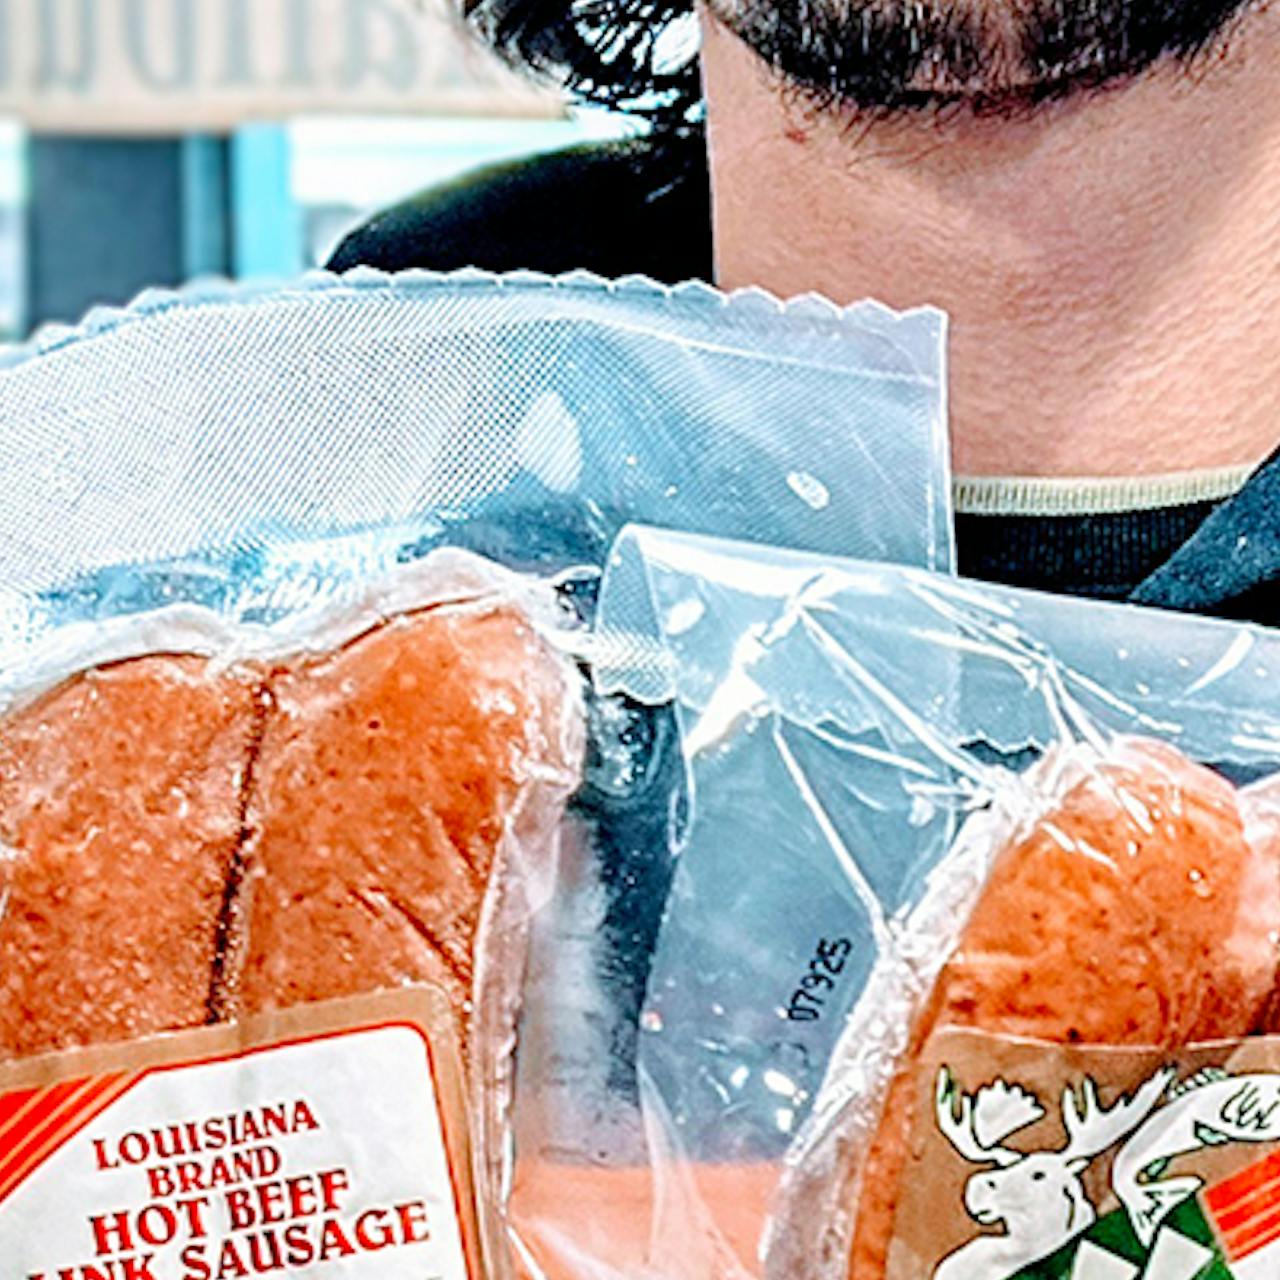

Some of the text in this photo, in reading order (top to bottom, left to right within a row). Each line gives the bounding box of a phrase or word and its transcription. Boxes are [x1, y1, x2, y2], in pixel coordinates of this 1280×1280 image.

[93, 1099, 319, 1170] LOUISIANA
[147, 1145, 282, 1199] BRAND
[89, 1167, 350, 1256] HOT BEEF
